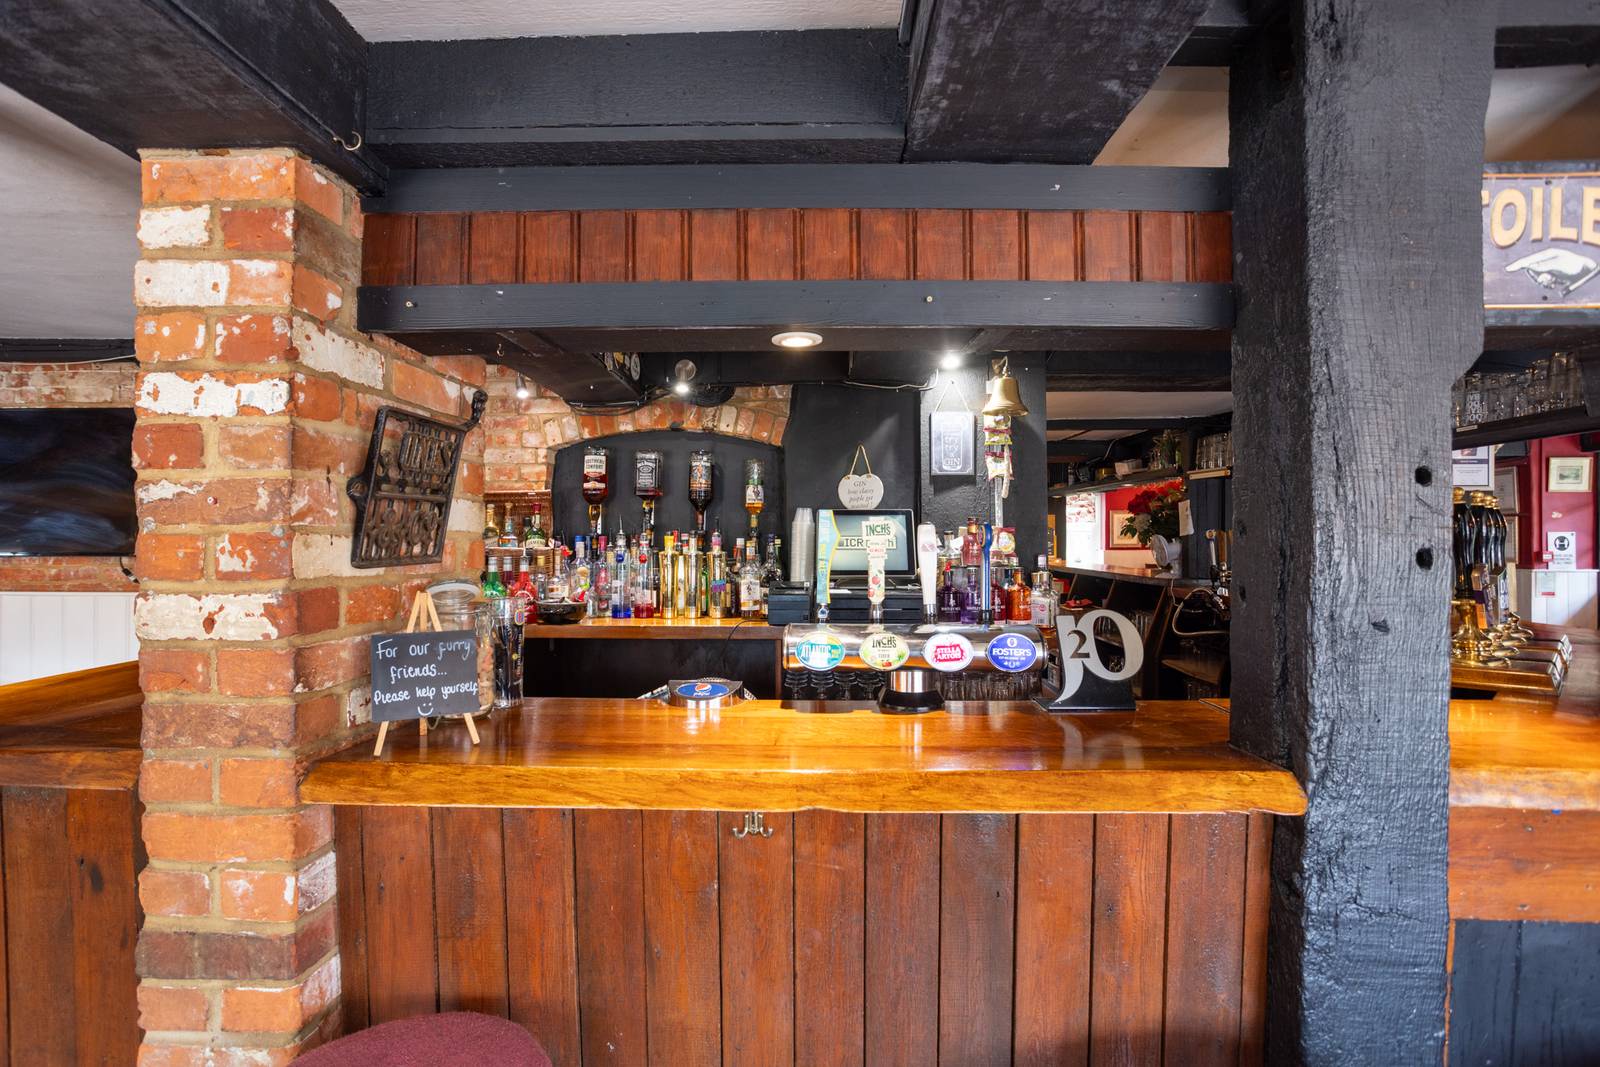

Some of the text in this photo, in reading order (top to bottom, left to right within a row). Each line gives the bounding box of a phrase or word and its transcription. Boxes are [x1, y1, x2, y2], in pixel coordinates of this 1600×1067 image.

[1481, 186, 1600, 248] OILE
[943, 457, 960, 465] GIN
[376, 638, 471, 661] For our furry
[992, 648, 1031, 656] FOSTER'S
[390, 664, 447, 684] friends...
[373, 681, 479, 705] Please help yourself
